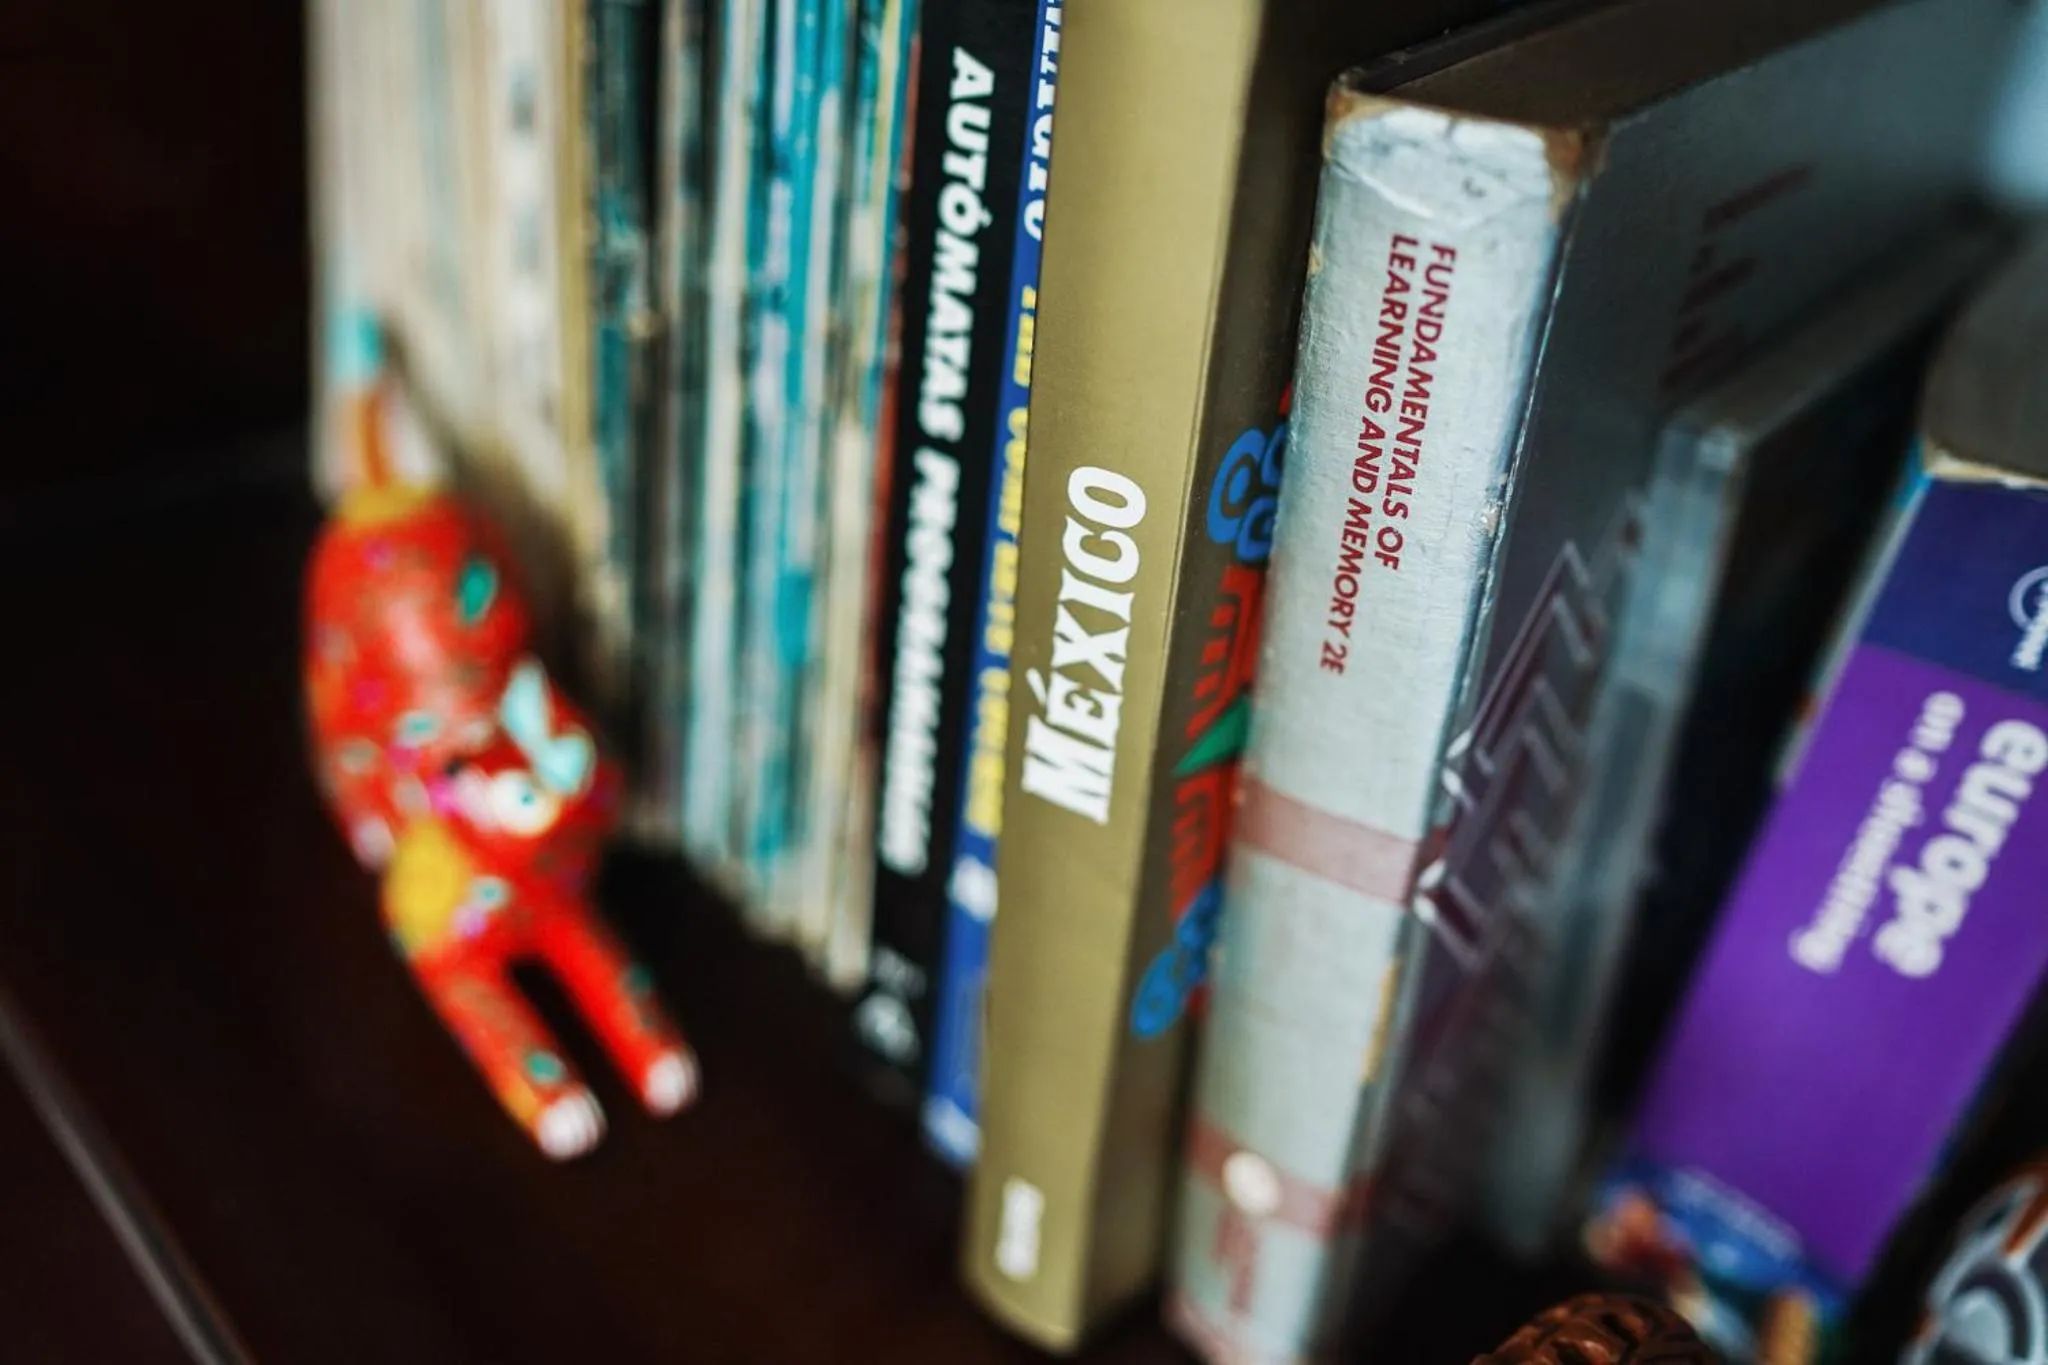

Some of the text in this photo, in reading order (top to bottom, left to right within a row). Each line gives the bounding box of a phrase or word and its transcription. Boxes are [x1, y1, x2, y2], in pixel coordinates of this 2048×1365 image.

[918, 46, 994, 443] AUTÓMATAS
[1374, 243, 1457, 571] FUNDAMENTALS OF
[1319, 233, 1419, 676] LEARNING AND MEMORY 2E
[1021, 465, 1147, 825] MÉXICO
[1872, 718, 2048, 979] europe
